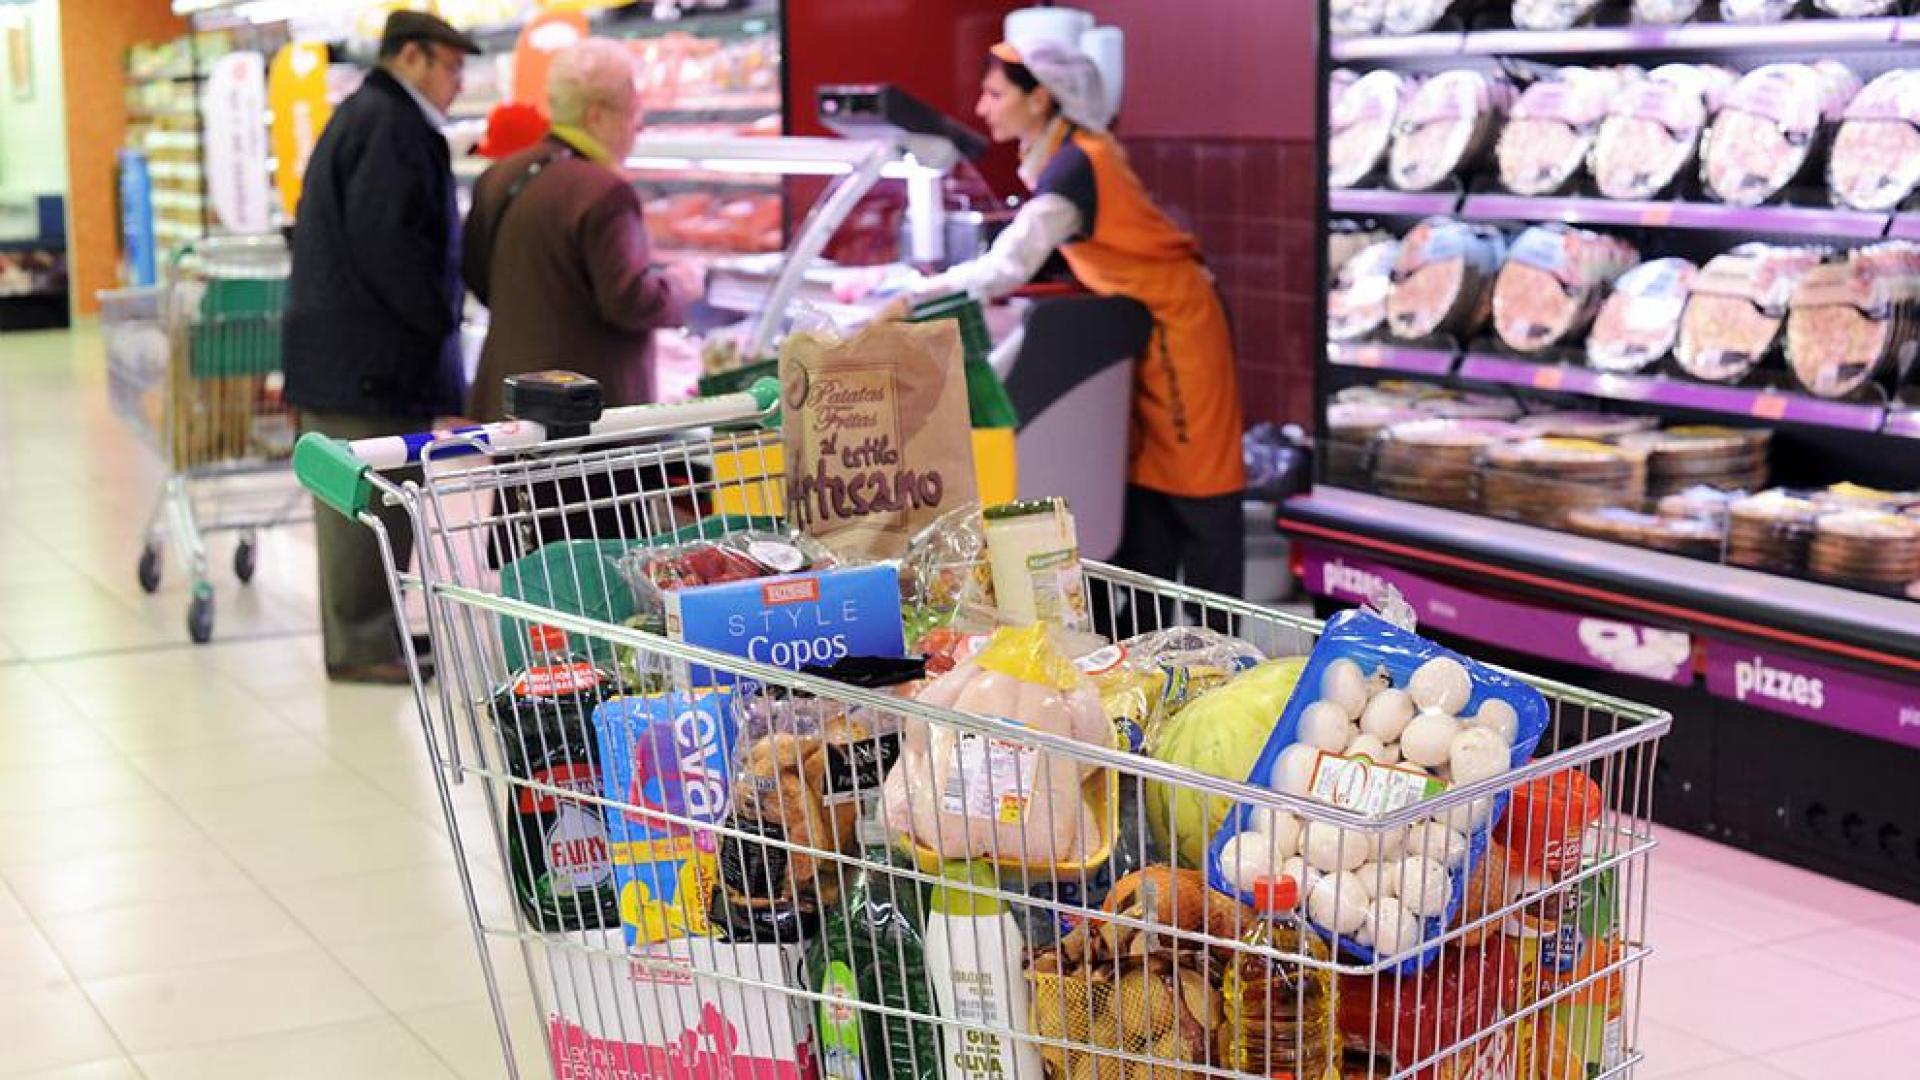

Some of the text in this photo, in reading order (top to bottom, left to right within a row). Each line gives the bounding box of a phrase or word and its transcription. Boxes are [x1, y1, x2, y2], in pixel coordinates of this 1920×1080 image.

[808, 378, 885, 407] Patatas
[813, 406, 878, 433] Fritas
[841, 434, 899, 469] estilo
[728, 600, 858, 637] STYLE
[747, 633, 848, 671] Copos
[1735, 656, 1824, 709] pizzes
